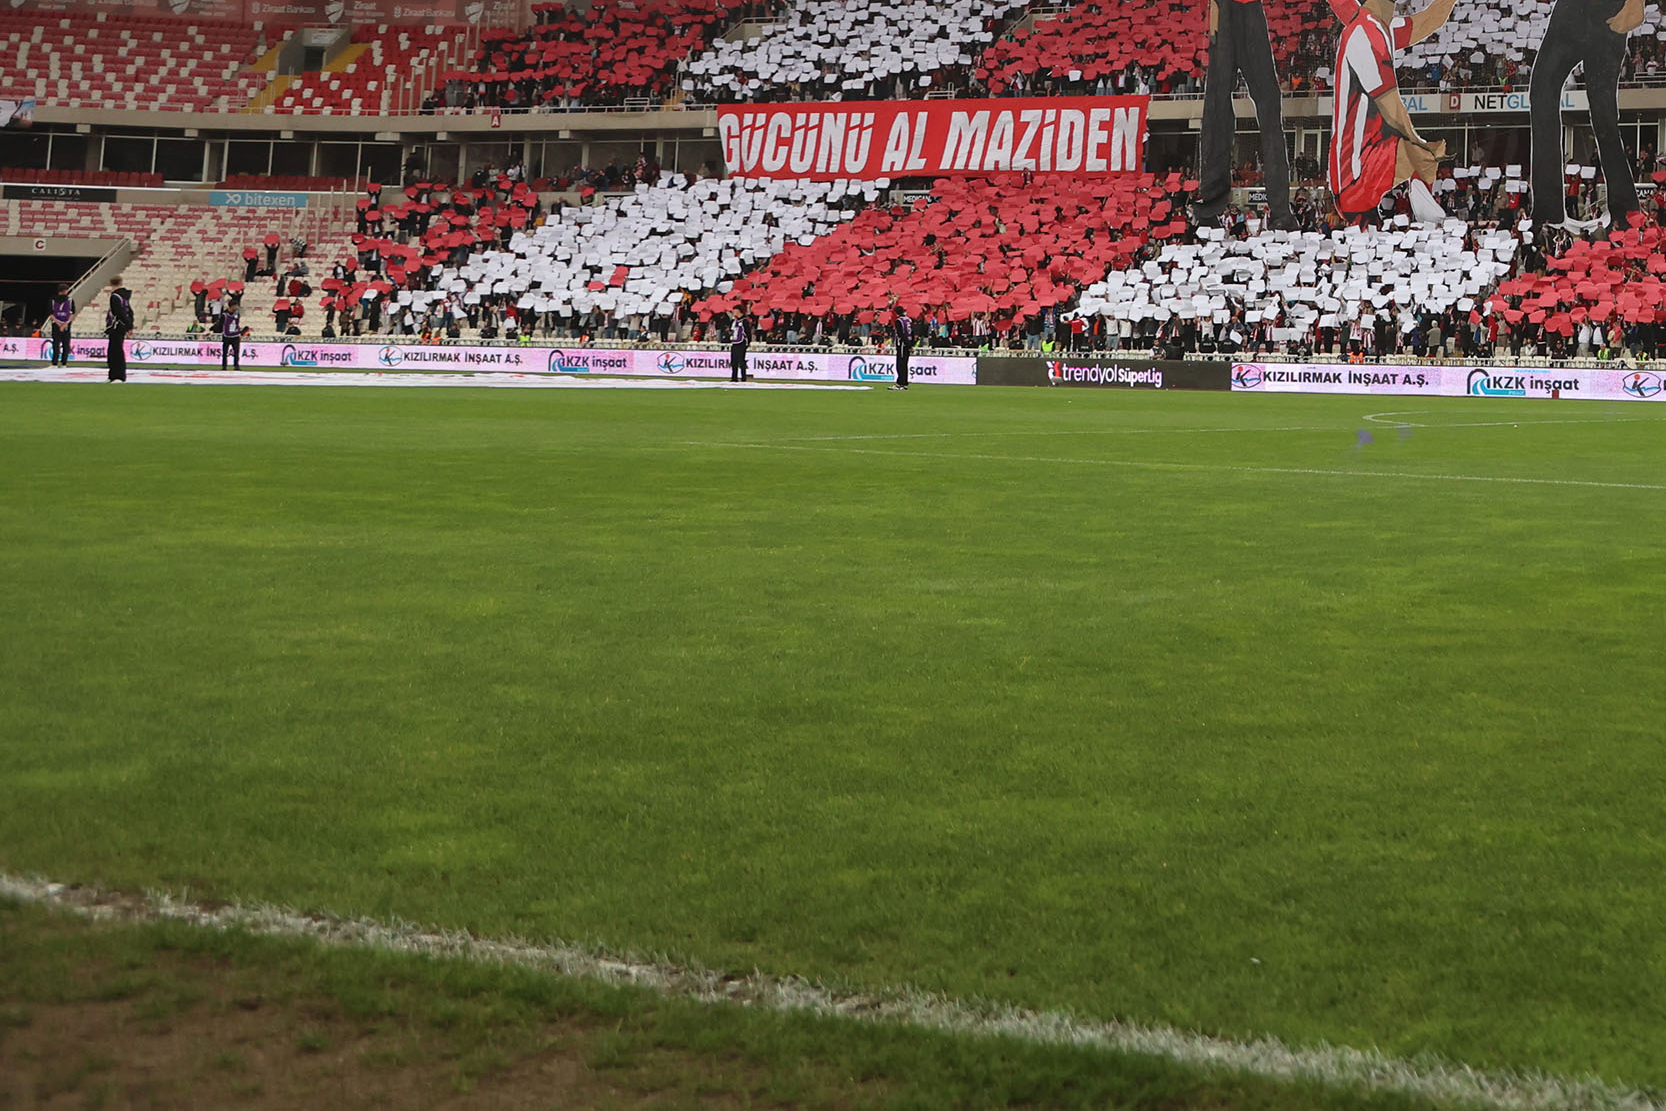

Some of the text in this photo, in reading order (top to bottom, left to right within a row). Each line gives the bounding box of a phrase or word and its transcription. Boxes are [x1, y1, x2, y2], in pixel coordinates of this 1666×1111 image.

[1450, 95, 1459, 108] D
[492, 115, 500, 127] A
[718, 111, 875, 173] GÜCÜNÜ
[880, 111, 929, 171] AL
[244, 192, 296, 207] bitexen
[35, 239, 45, 250] C
[152, 347, 204, 357] KIZILIRMAK
[403, 351, 461, 363] KIZILIRMAK
[464, 351, 502, 366] İNŞAAT
[592, 356, 627, 371] inşaat
[753, 357, 793, 373] İNŞAAT
[909, 365, 938, 379] şaat
[1062, 362, 1118, 385] trendyol
[1263, 370, 1343, 385] KIZILIRMAK
[1348, 369, 1399, 387] İNŞAAT
[1530, 375, 1580, 392] inşaat
